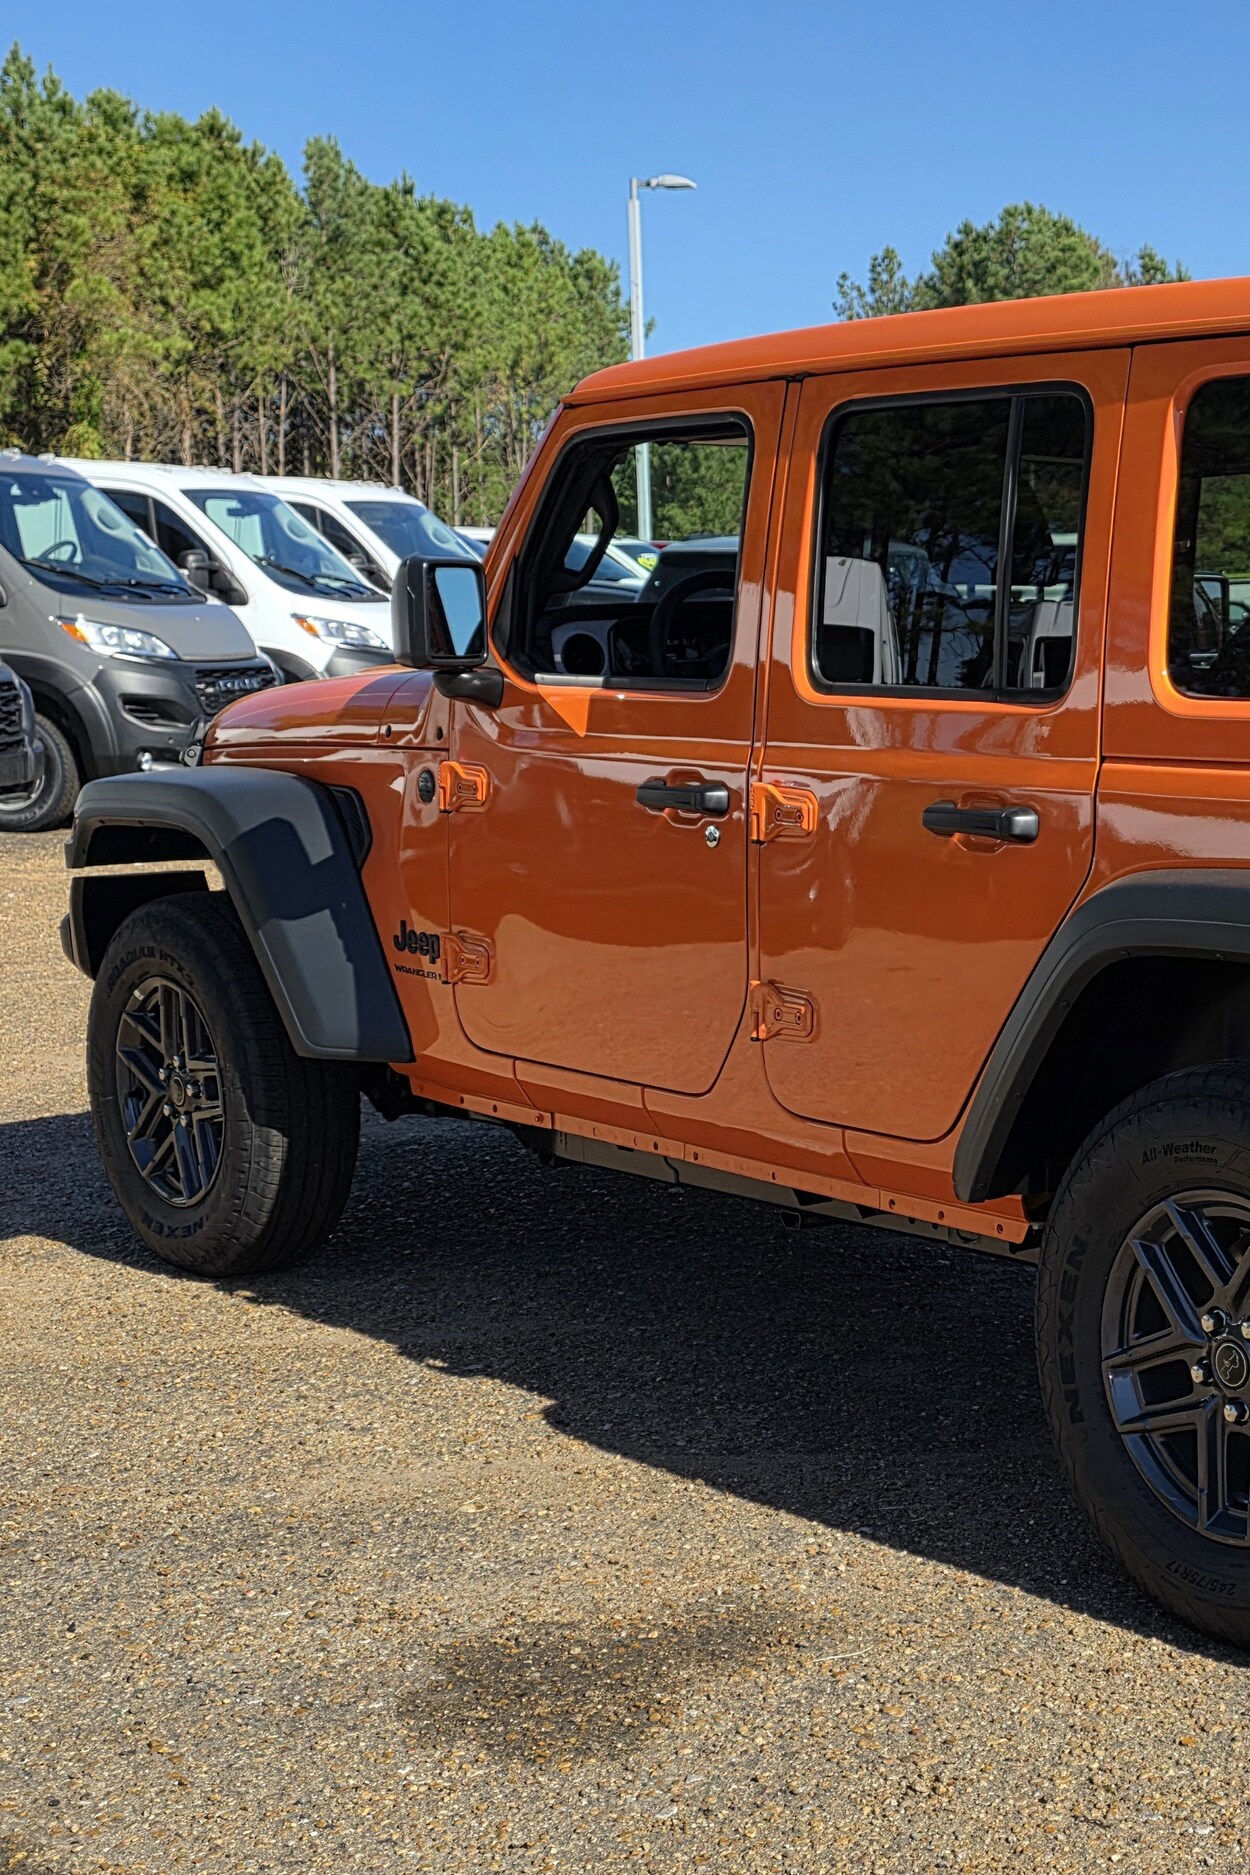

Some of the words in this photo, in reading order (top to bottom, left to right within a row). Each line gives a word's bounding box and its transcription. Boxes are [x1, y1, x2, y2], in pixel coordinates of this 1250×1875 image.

[393, 919, 441, 965] Jeep
[393, 963, 438, 981] WRANGLER
[1142, 1140, 1218, 1165] All-Weather
[1058, 1235, 1087, 1424] NEXEN
[1165, 1560, 1238, 1596] 245/75R17
